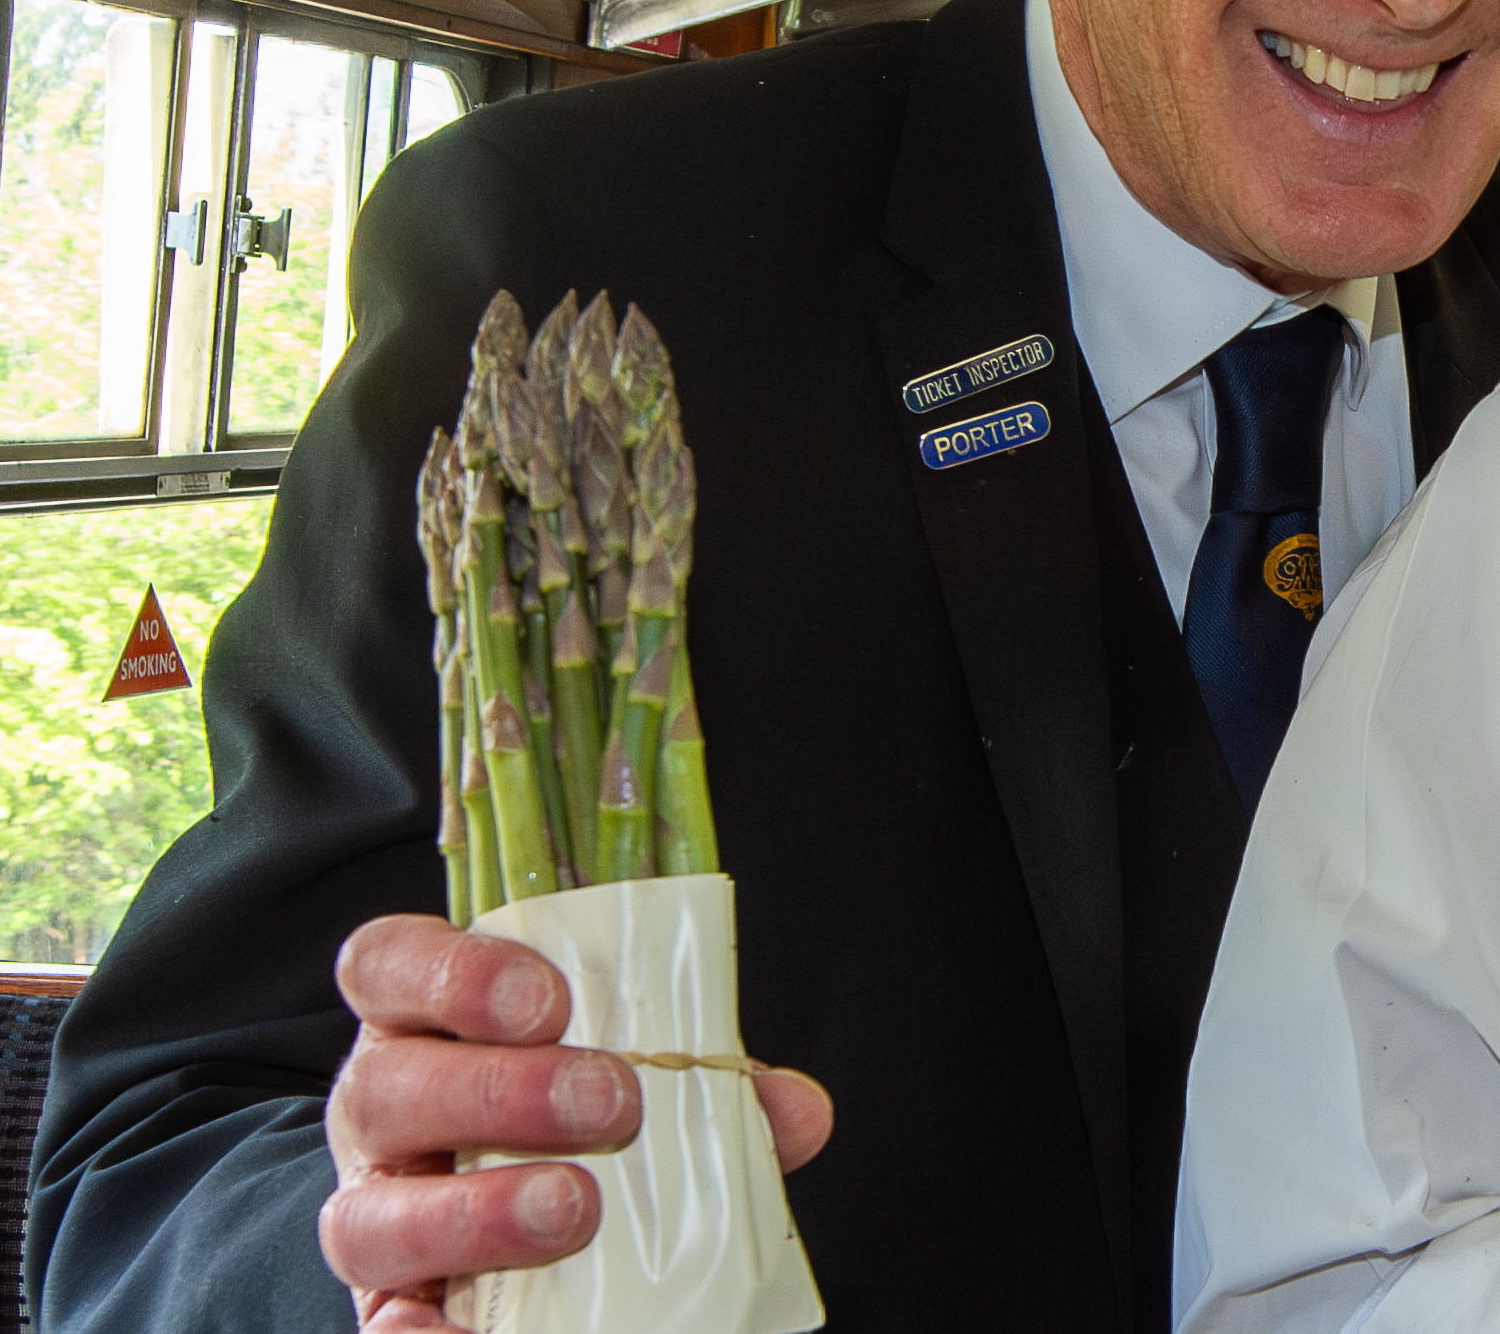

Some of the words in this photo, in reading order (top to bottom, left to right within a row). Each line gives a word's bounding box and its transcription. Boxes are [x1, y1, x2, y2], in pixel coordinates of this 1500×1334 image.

[911, 372, 964, 407] TICKET
[966, 341, 1046, 386] INSPECTOR
[934, 411, 1037, 463] PORTER
[139, 619, 160, 642] NO
[120, 651, 177, 681] SMOKING
